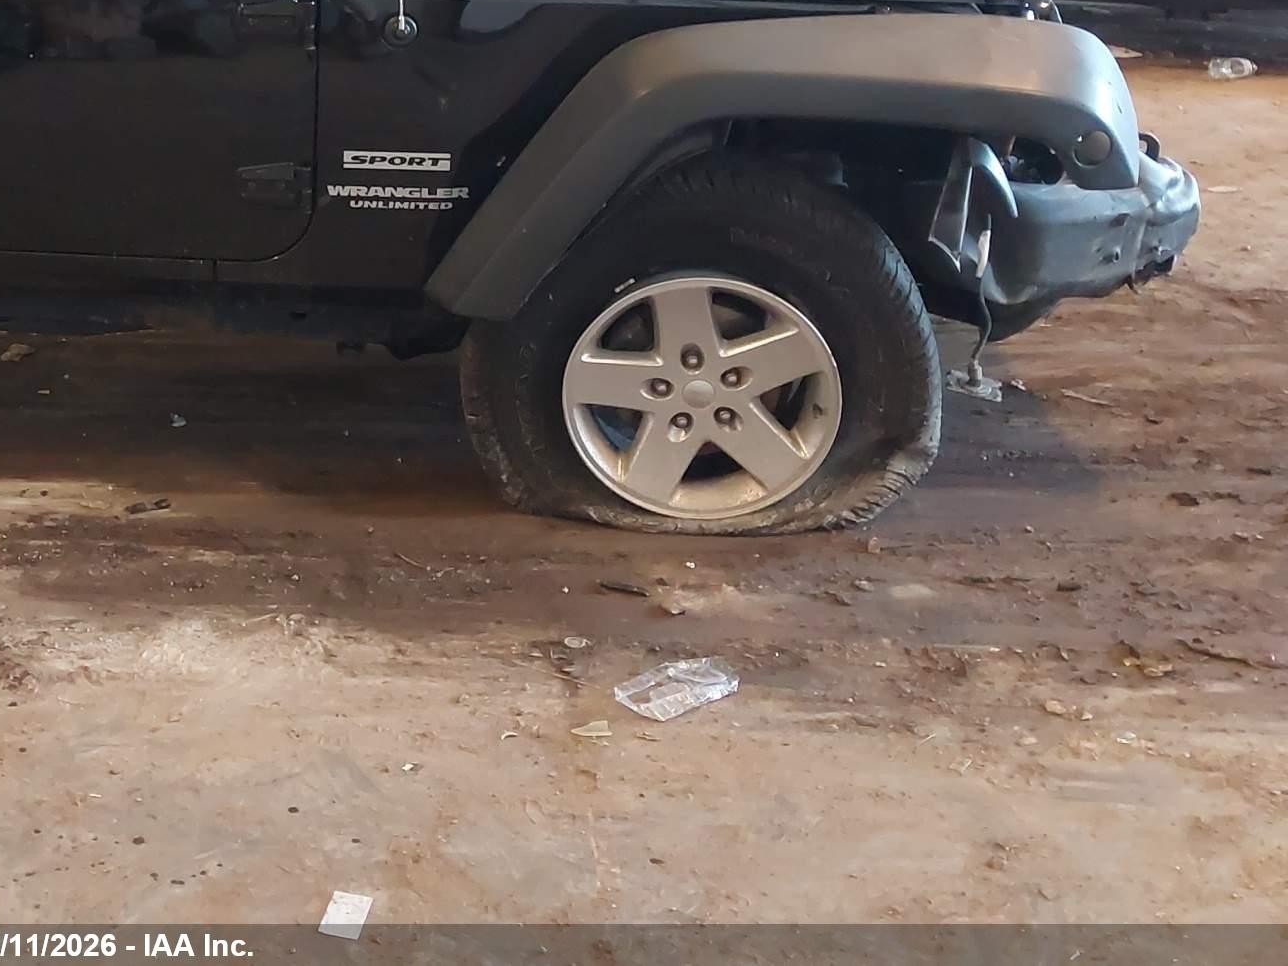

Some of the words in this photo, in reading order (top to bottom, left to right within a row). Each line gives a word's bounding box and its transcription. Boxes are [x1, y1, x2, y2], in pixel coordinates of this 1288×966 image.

[346, 155, 450, 167] SPORT
[327, 185, 470, 199] WRANGLER
[350, 200, 453, 210] UNLIMITED
